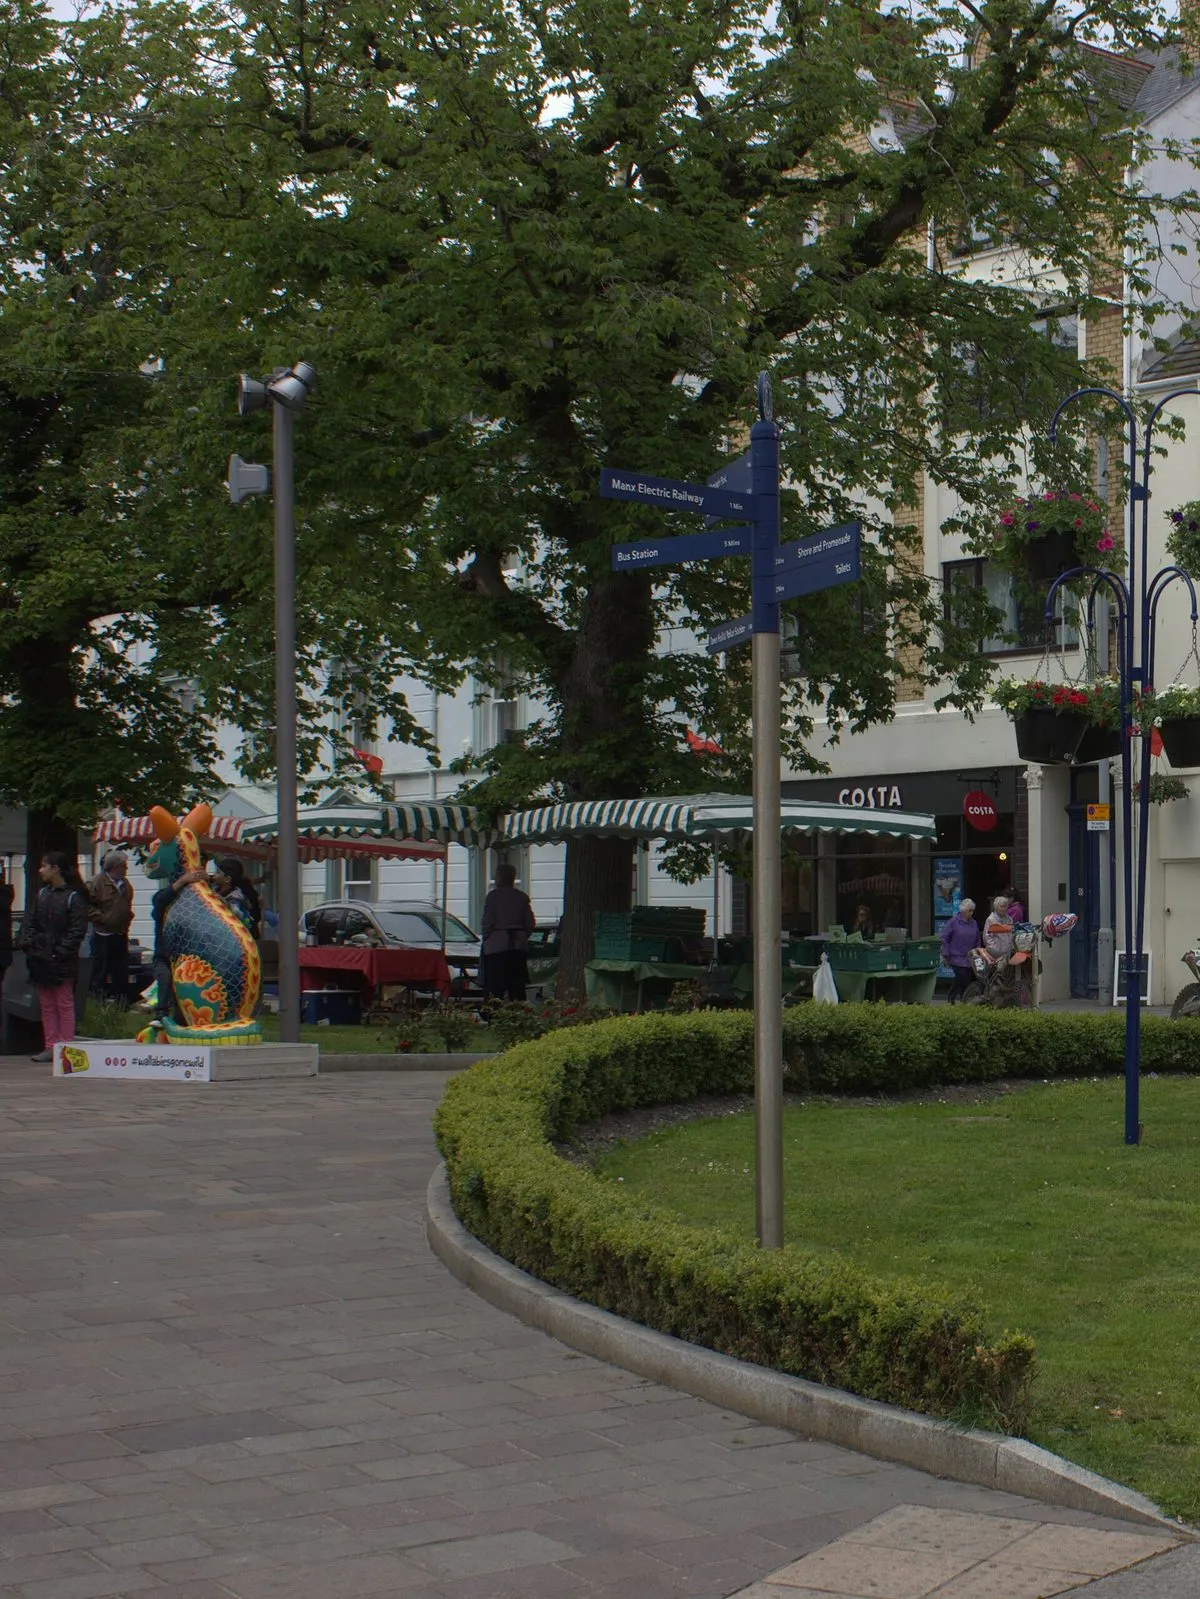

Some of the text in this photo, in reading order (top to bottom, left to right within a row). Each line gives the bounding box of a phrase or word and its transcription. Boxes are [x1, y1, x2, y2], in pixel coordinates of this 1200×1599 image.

[611, 478, 705, 506] Manx Electric Railway
[733, 503, 743, 511] Min
[728, 539, 741, 547] Mins
[797, 533, 851, 559] Shore and Promenade
[617, 548, 659, 562] Bus Station
[835, 562, 851, 575] Toilets
[838, 786, 902, 808] COSTA
[968, 806, 994, 816] COSTA
[131, 1054, 205, 1069] #wallabiesgonewild
